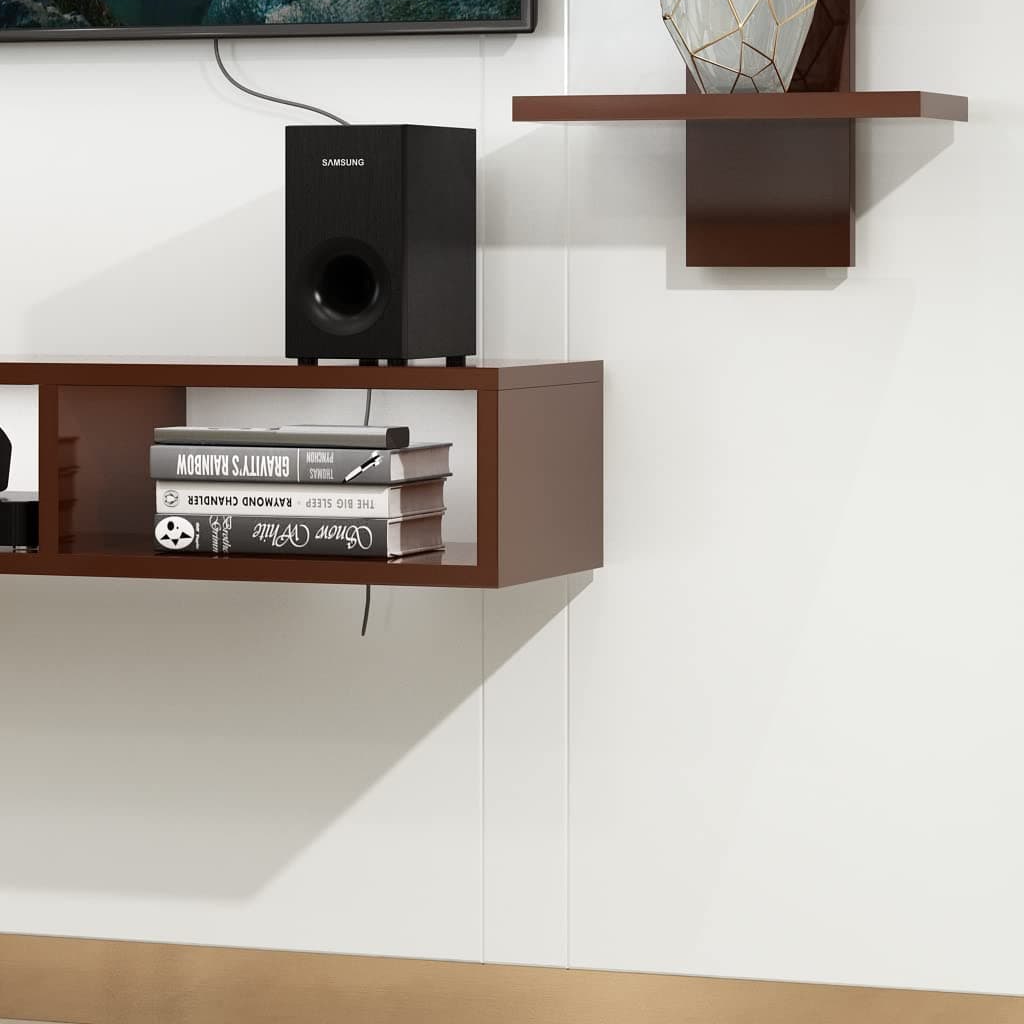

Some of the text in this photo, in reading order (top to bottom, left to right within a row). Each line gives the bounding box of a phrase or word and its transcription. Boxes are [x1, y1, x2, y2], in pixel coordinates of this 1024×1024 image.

[321, 158, 365, 167] SAMSUNG
[306, 451, 334, 463] PYNCHON
[176, 453, 290, 477] GRAVITY'S RAINBOW
[309, 466, 334, 480] THOMAS
[187, 494, 292, 507] RAYMOND CHANDLER
[305, 497, 375, 509] THE BIG SLEEP
[252, 521, 373, 550] Snow White
